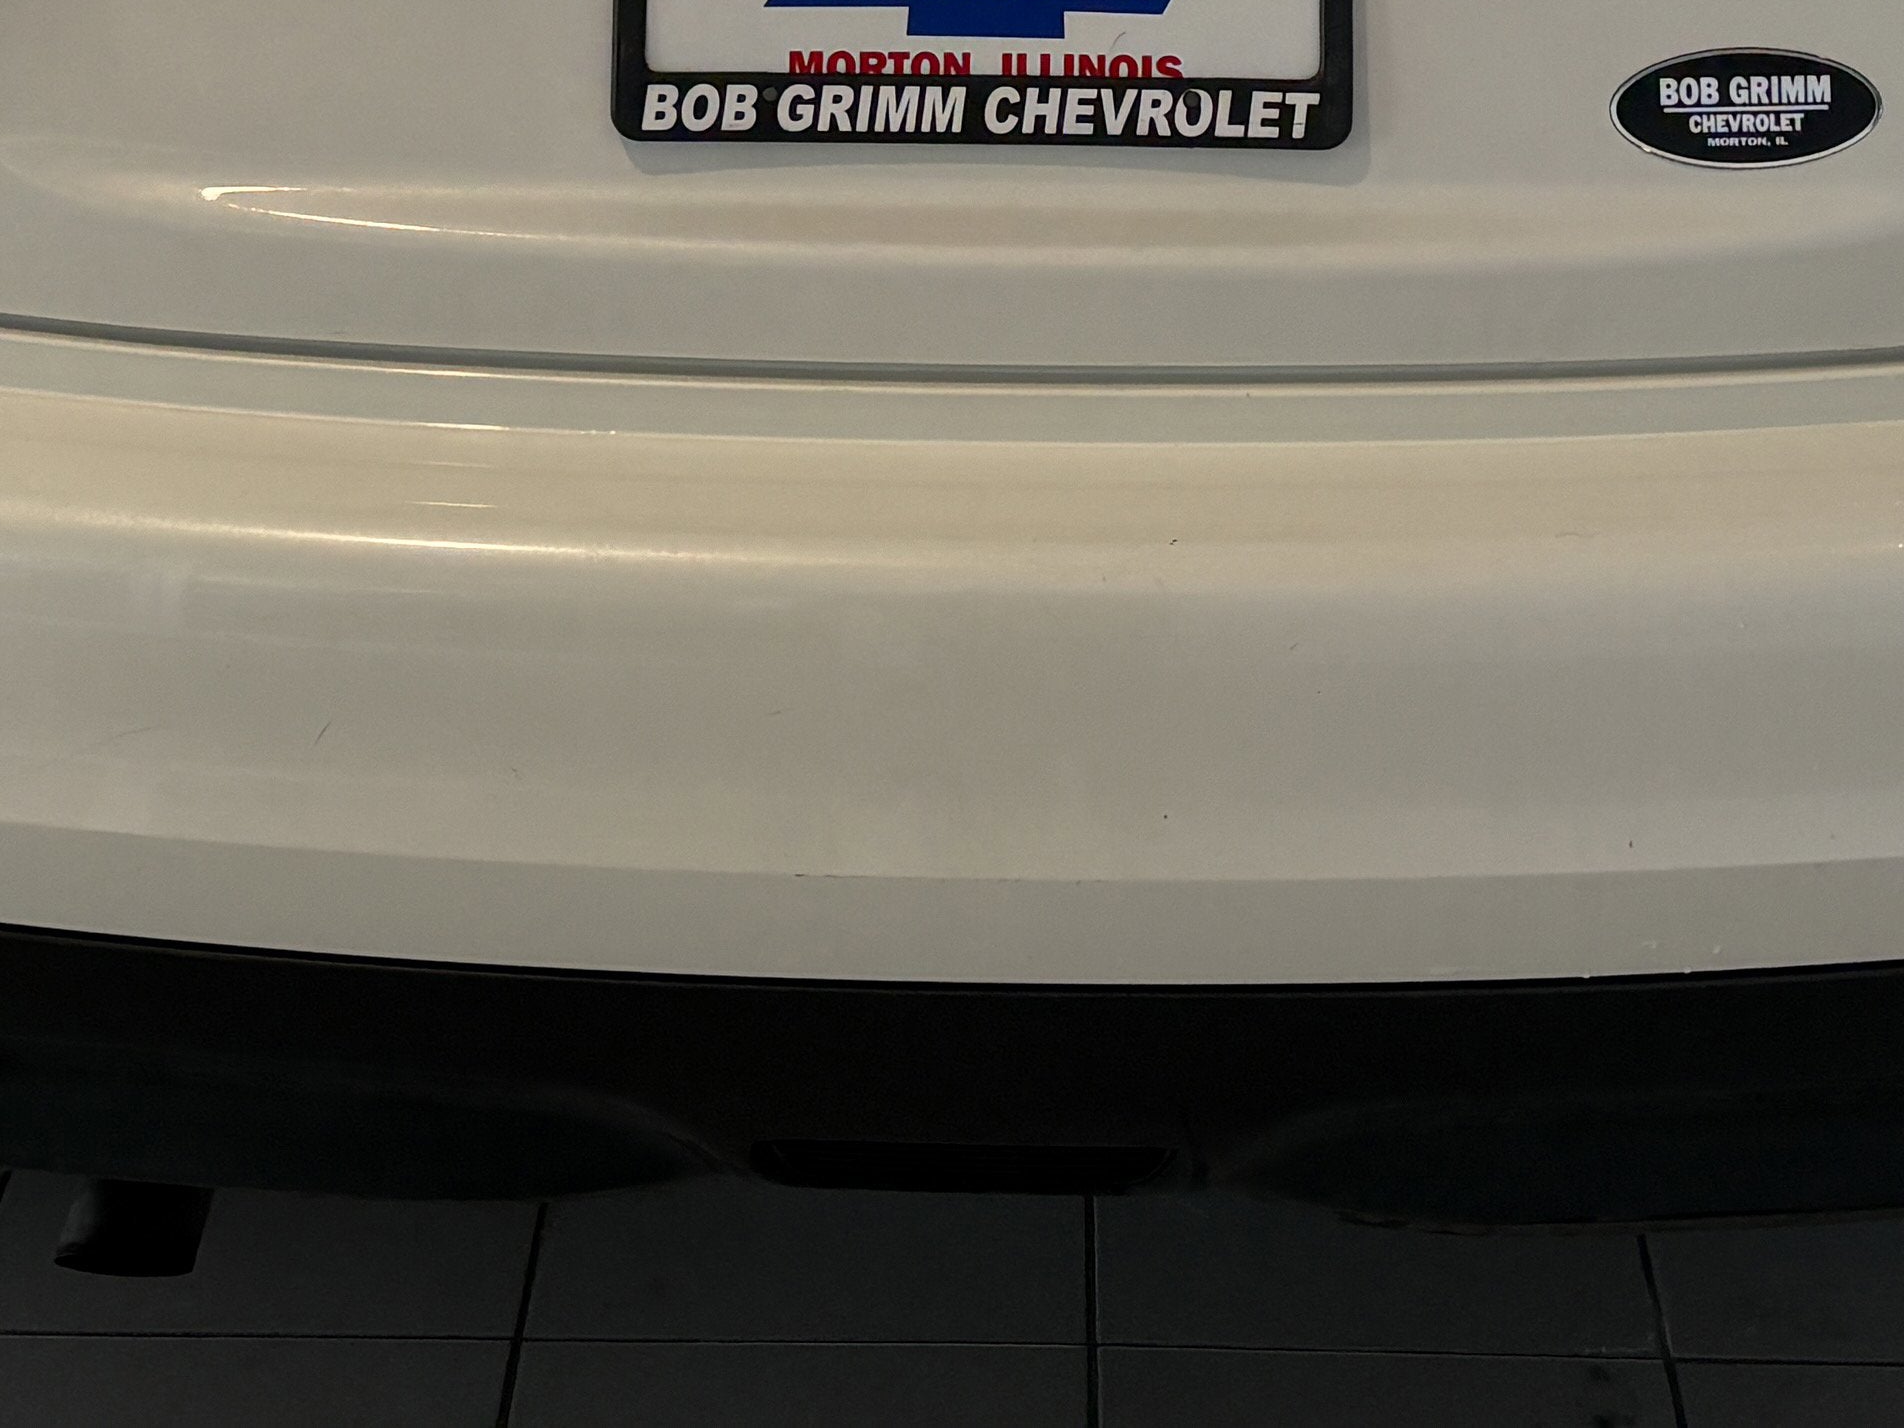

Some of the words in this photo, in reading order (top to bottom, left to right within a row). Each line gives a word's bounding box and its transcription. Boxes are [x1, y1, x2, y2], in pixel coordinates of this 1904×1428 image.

[1658, 76, 1720, 107] BOB
[1729, 74, 1832, 105] GRIMM
[640, 83, 758, 132] BOB
[776, 84, 965, 134] GRIMM
[983, 88, 1321, 140] CHEVROLET
[1688, 113, 1805, 134] CHEVROLET
[1707, 136, 1771, 147] MORTON,
[1775, 136, 1789, 146] IL
